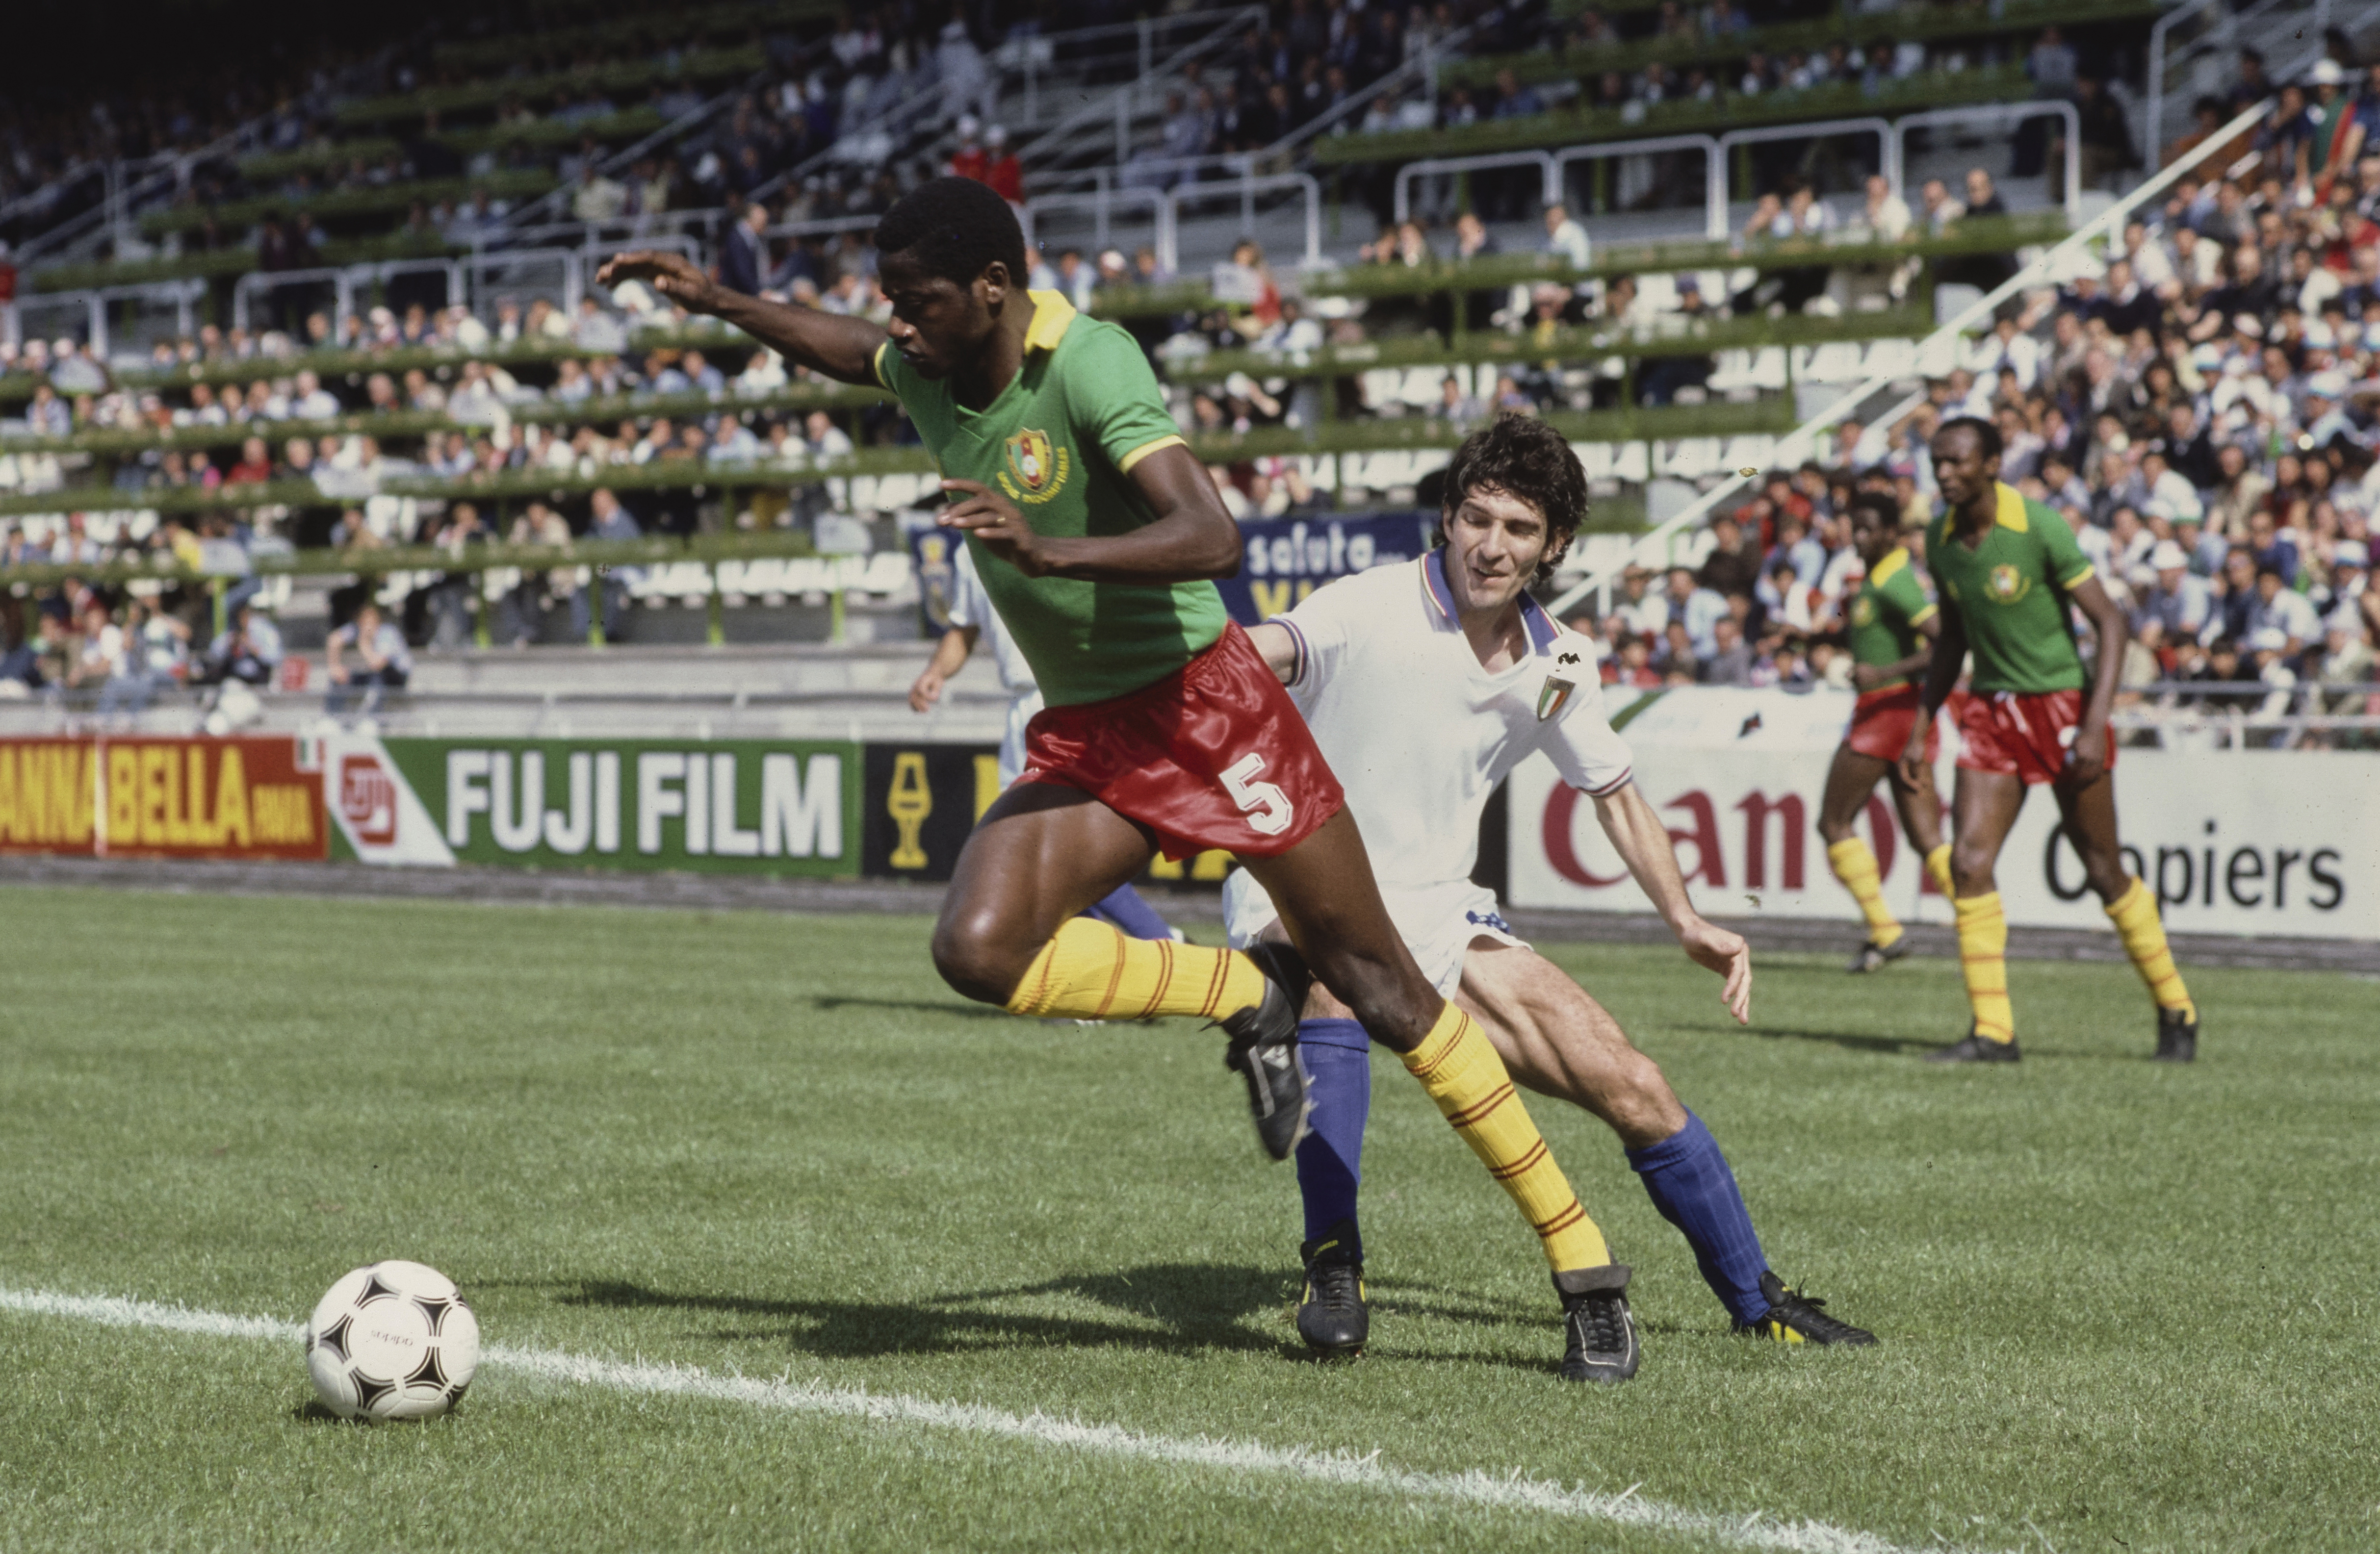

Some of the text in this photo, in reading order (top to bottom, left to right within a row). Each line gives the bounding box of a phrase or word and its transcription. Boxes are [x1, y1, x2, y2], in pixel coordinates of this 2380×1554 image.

[1246, 522, 1375, 576] saluta
[446, 749, 842, 858] FUJI FILM
[1218, 752, 1293, 835] 5
[1542, 776, 1948, 895] Can
